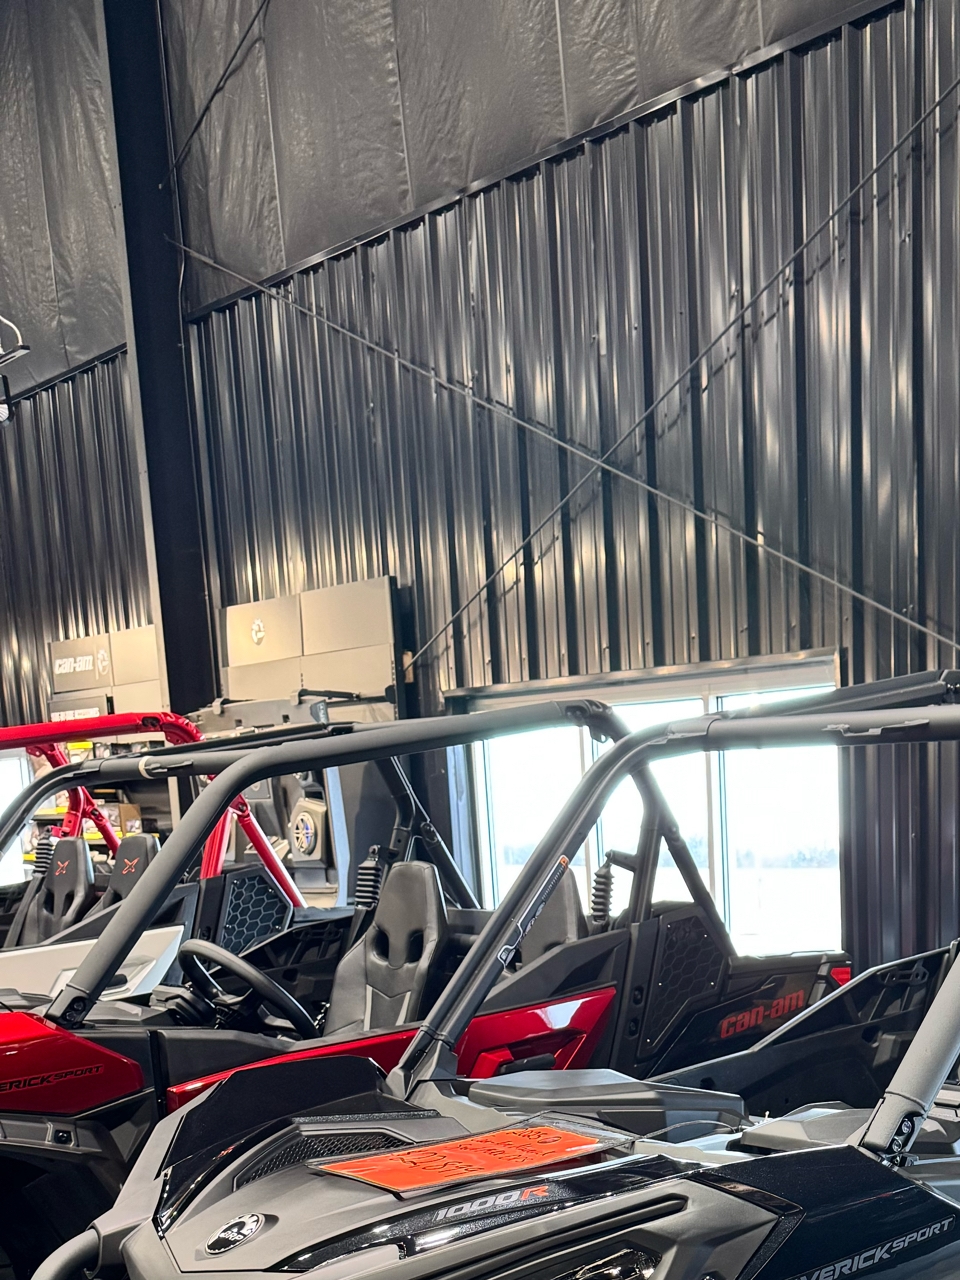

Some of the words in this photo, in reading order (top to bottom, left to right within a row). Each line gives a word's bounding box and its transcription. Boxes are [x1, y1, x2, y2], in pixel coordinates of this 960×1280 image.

[720, 989, 805, 1039] can-am
[53, 1065, 104, 1080] SPORT
[431, 1185, 549, 1221] 1000R
[222, 1229, 244, 1241] BRP
[891, 1217, 954, 1253] SPORT
